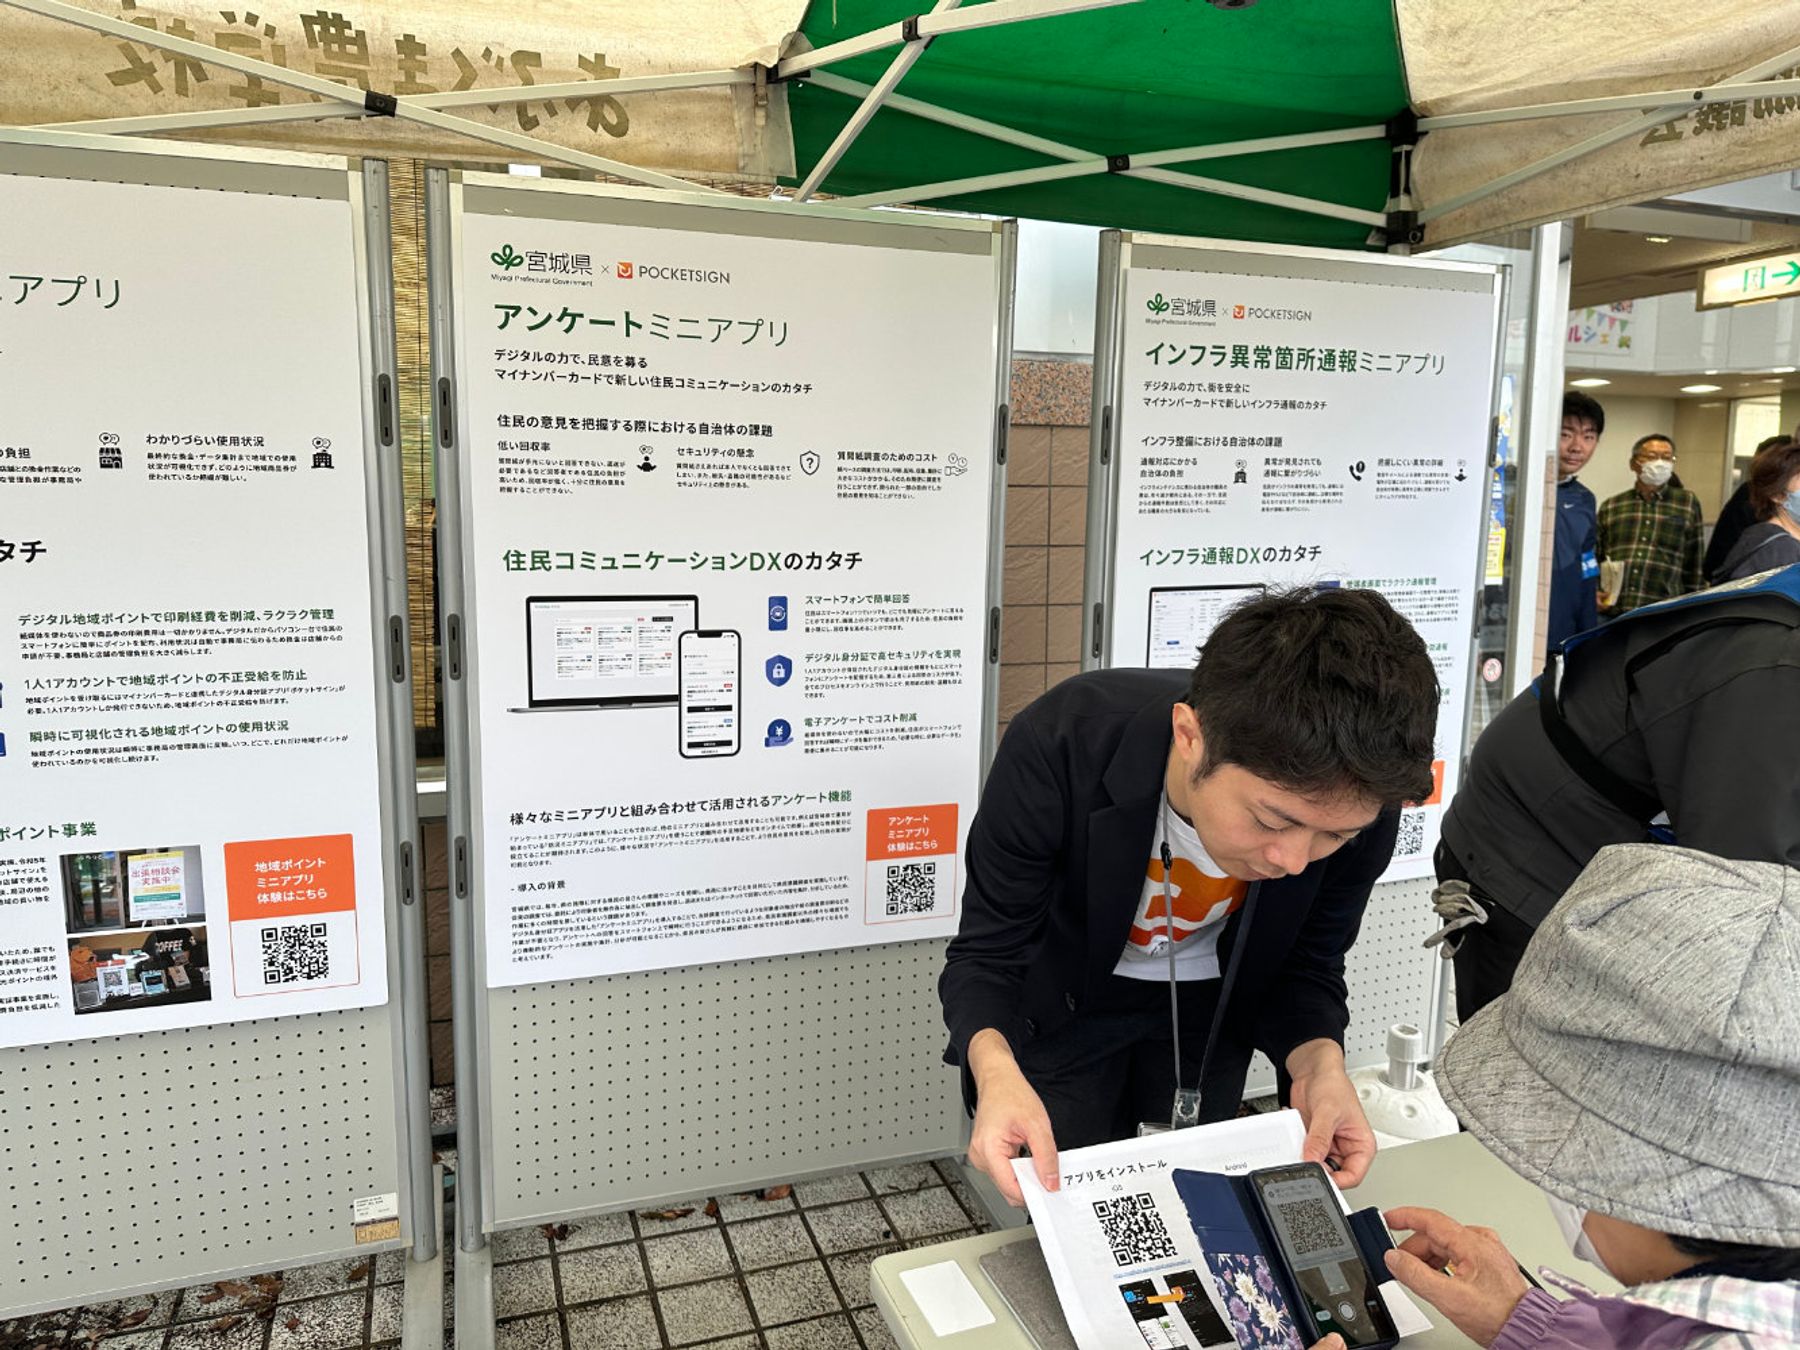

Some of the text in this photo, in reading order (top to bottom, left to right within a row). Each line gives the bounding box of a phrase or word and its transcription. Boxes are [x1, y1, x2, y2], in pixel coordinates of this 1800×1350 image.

[526, 249, 593, 276] 宮城県
[638, 264, 731, 285] POCKETSIGN
[491, 273, 513, 283] Miyagi
[552, 277, 593, 287] Government
[0, 275, 121, 309] アプリ
[1171, 298, 1217, 318] 宮城県
[1248, 306, 1312, 322] POCKETSIGN
[494, 303, 788, 347] アンケートミニアプリ
[494, 348, 648, 369] デジタルの力で、民意を募る
[1145, 341, 1446, 375] インフラ異常箇所通報ミニアプリ
[494, 367, 813, 395] マイナンバーカードで新しい住民コミュニケーションのカタチ
[1143, 381, 1251, 394] デジタルの力で、街を安全に
[1143, 396, 1328, 411] マイナンバーカードで新しいインフラ通報のカタチ
[497, 413, 774, 438] 住民の意見を把握する際における自治体の課題
[146, 434, 264, 448] わかりづらい使用状況
[497, 440, 551, 452] 低い回収率
[1141, 435, 1283, 448] インフラ整備における自治体の課題
[676, 446, 755, 458] セキュリティの懸念
[837, 451, 938, 462] 質問紙調査のためのコスト
[1140, 457, 1198, 466] 通報対応にかかる
[1263, 457, 1322, 467] 異常が発見されても
[1140, 469, 1185, 478] 自治体の負担
[502, 548, 864, 574] 住民コミュニケーションDXのカタチ
[1140, 544, 1322, 566] インフラ通報DXのカタチ
[805, 594, 910, 604] スマートフォンで簡単回答
[18, 608, 335, 626] デジタル地域ポイントで印刷経費を削減、ラクラク管理
[804, 648, 962, 663] デジタル身分証で高セキュリティを実現
[24, 669, 307, 690] 1人1アカウントで地域ポイントの不正受給を防止
[804, 713, 918, 727] 電子アンケートでコスト削減
[29, 720, 289, 743] 瞬時に可視化される地域ポイントの使用状況
[510, 790, 852, 827] 様々なミニアプリと組み合わせて活用されるアンケート機能
[888, 813, 930, 826] アンケート
[0, 821, 97, 841] ポイント事業
[888, 827, 930, 839] ミニアプリ
[887, 839, 938, 853] 体験はこちら
[131, 865, 181, 878] 出張相談会
[254, 855, 327, 873] 地域ポイント
[256, 874, 314, 888] ミニアプリ
[517, 880, 566, 893] 導入の背景
[257, 888, 328, 904] 体験はこちら
[1063, 1159, 1167, 1187] アプリをインストール
